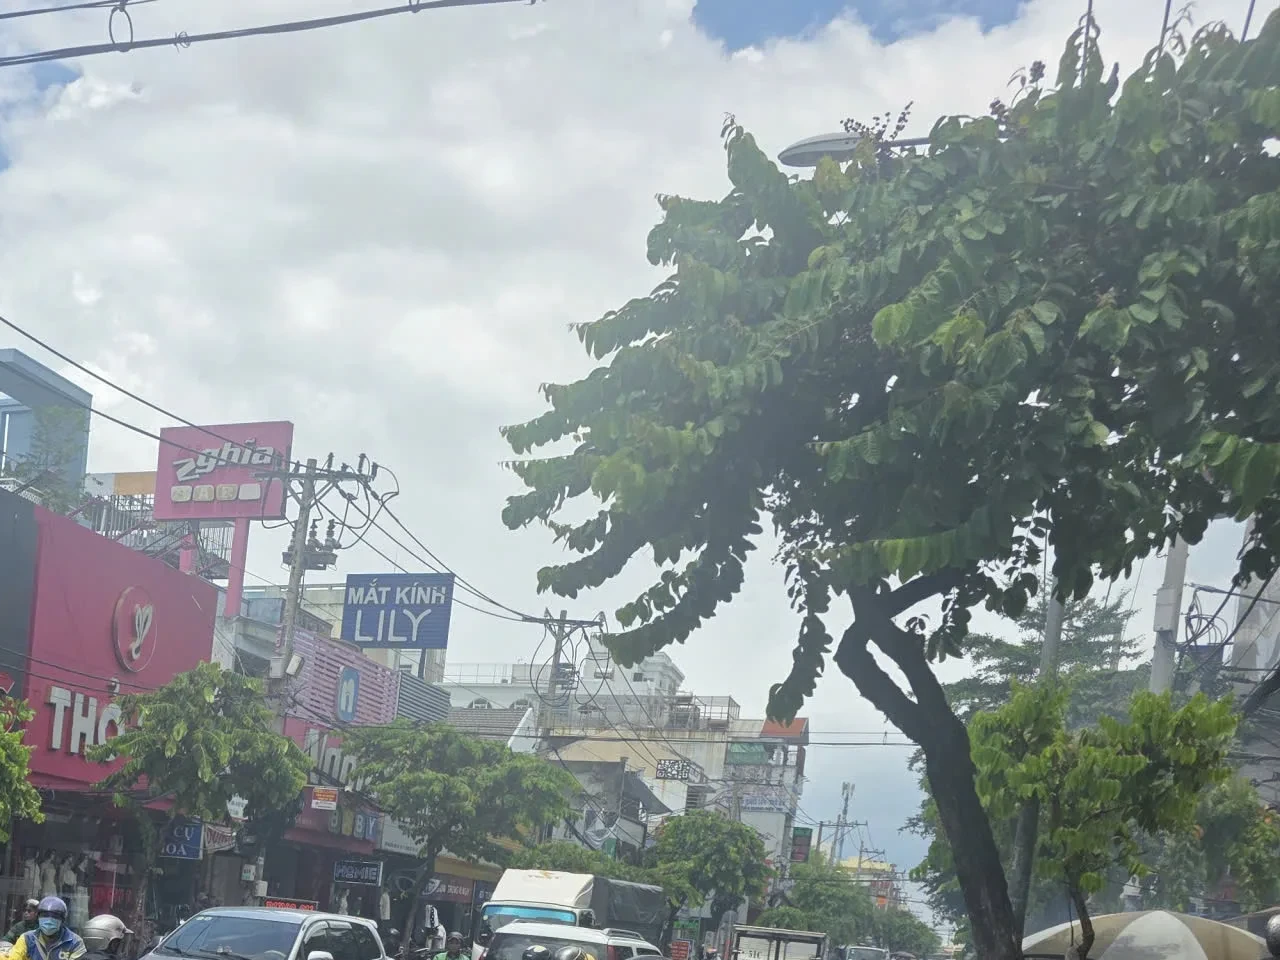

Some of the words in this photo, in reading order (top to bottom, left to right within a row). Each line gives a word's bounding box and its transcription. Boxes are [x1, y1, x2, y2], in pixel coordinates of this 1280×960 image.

[347, 578, 391, 605] MẮT
[395, 582, 446, 605] KÍNH
[355, 609, 431, 642] LILY
[162, 843, 187, 856] OA
